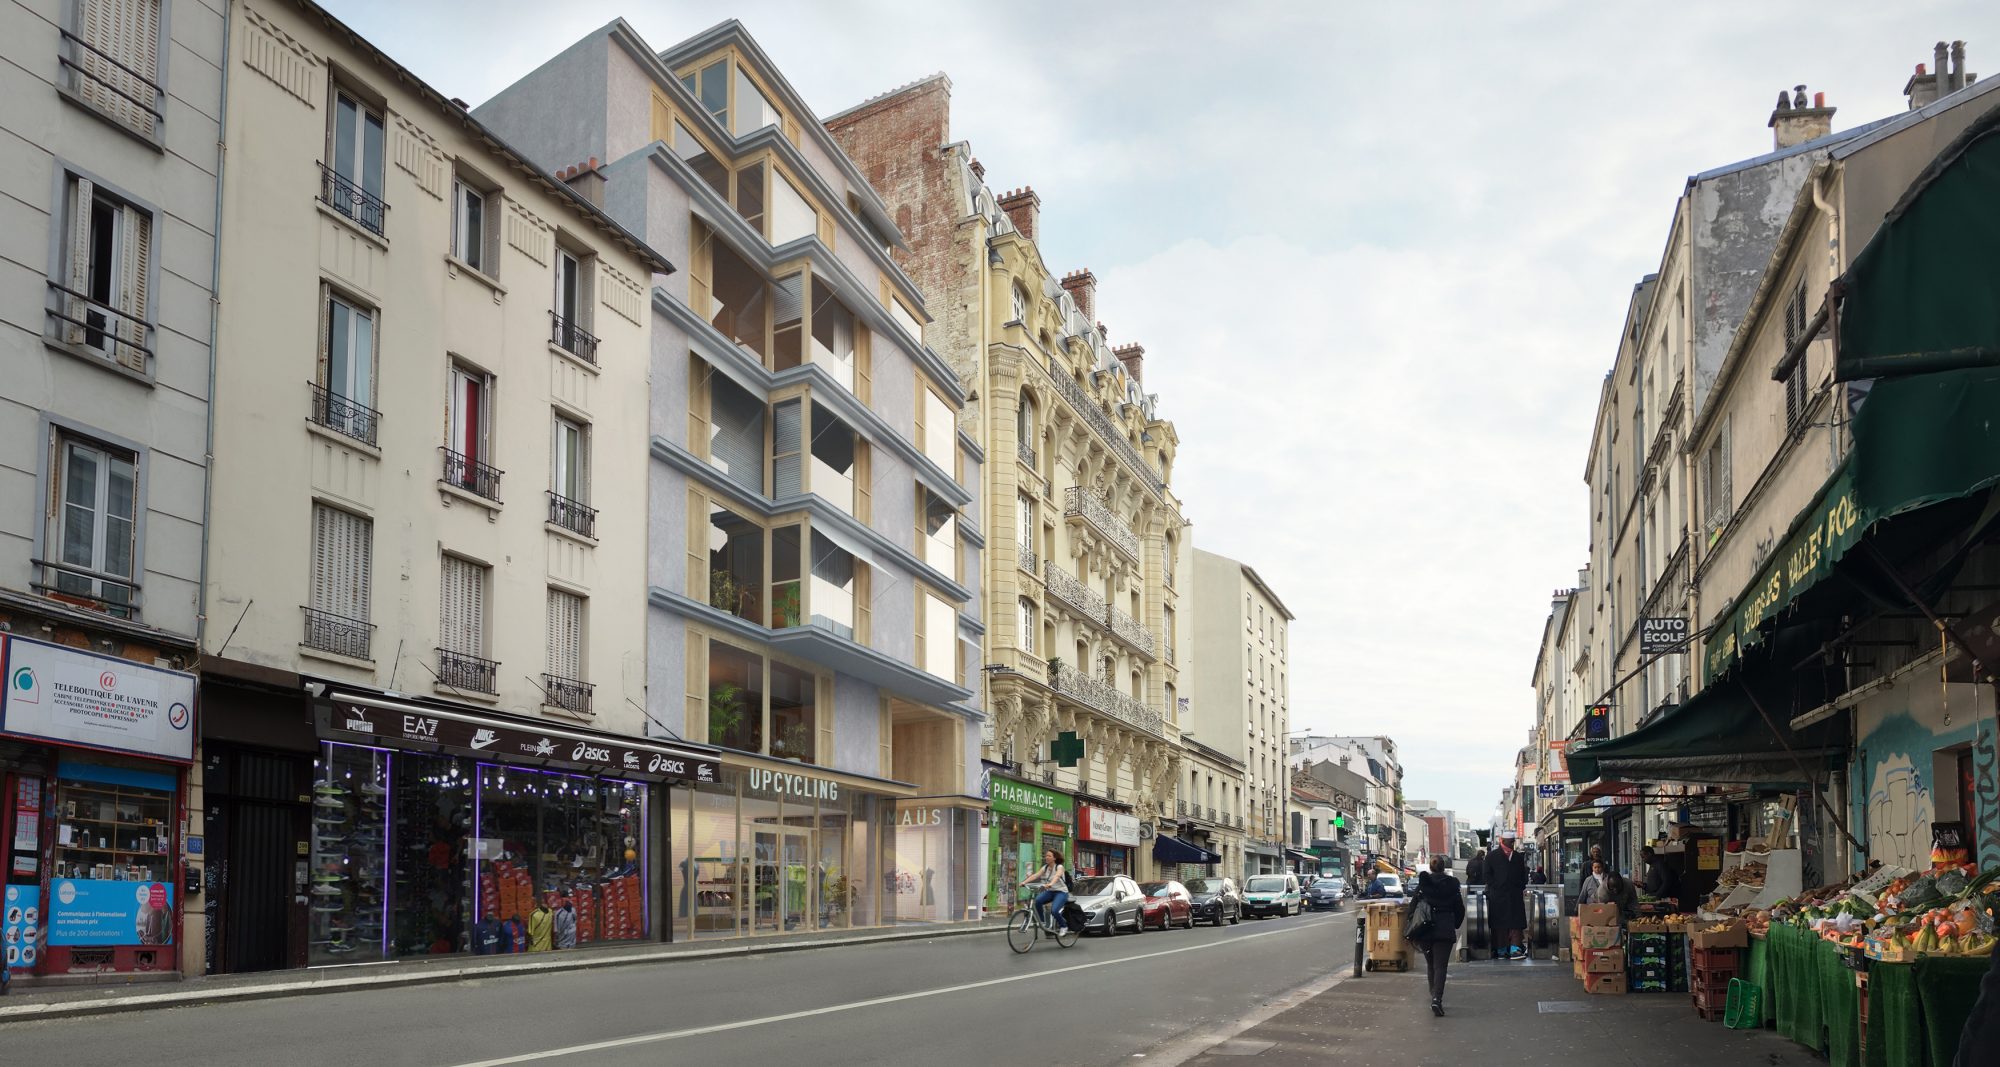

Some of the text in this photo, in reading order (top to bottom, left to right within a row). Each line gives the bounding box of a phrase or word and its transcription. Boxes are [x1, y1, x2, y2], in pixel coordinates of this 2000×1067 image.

[1643, 619, 1685, 631] AUTO
[1643, 630, 1685, 642] ÉCOLE
[53, 682, 158, 709] TELEBOUTIQUE DE L'AVENIR
[53, 692, 73, 700] CABINE
[73, 695, 112, 707] TELEPHONIQUE
[115, 703, 140, 713] INTERNET
[53, 698, 84, 708] ACCESSOIRE
[100, 706, 129, 716] DEBLOCAGE
[69, 707, 138, 723] PHOTOCOPIE IMPRESSION
[346, 718, 374, 733] PUMA
[403, 715, 439, 736] EA7
[475, 728, 495, 742] NIKE
[520, 743, 536, 752] PLEIN
[584, 746, 610, 762] asics
[660, 759, 685, 774] asics
[697, 775, 713, 783] LACOSTE
[750, 768, 838, 801] UPCYCLING
[993, 782, 1054, 810] PHARMACIE
[887, 806, 942, 825] MAÜS
[1265, 789, 1273, 836] HOTEL
[57, 910, 91, 918] Communiquez
